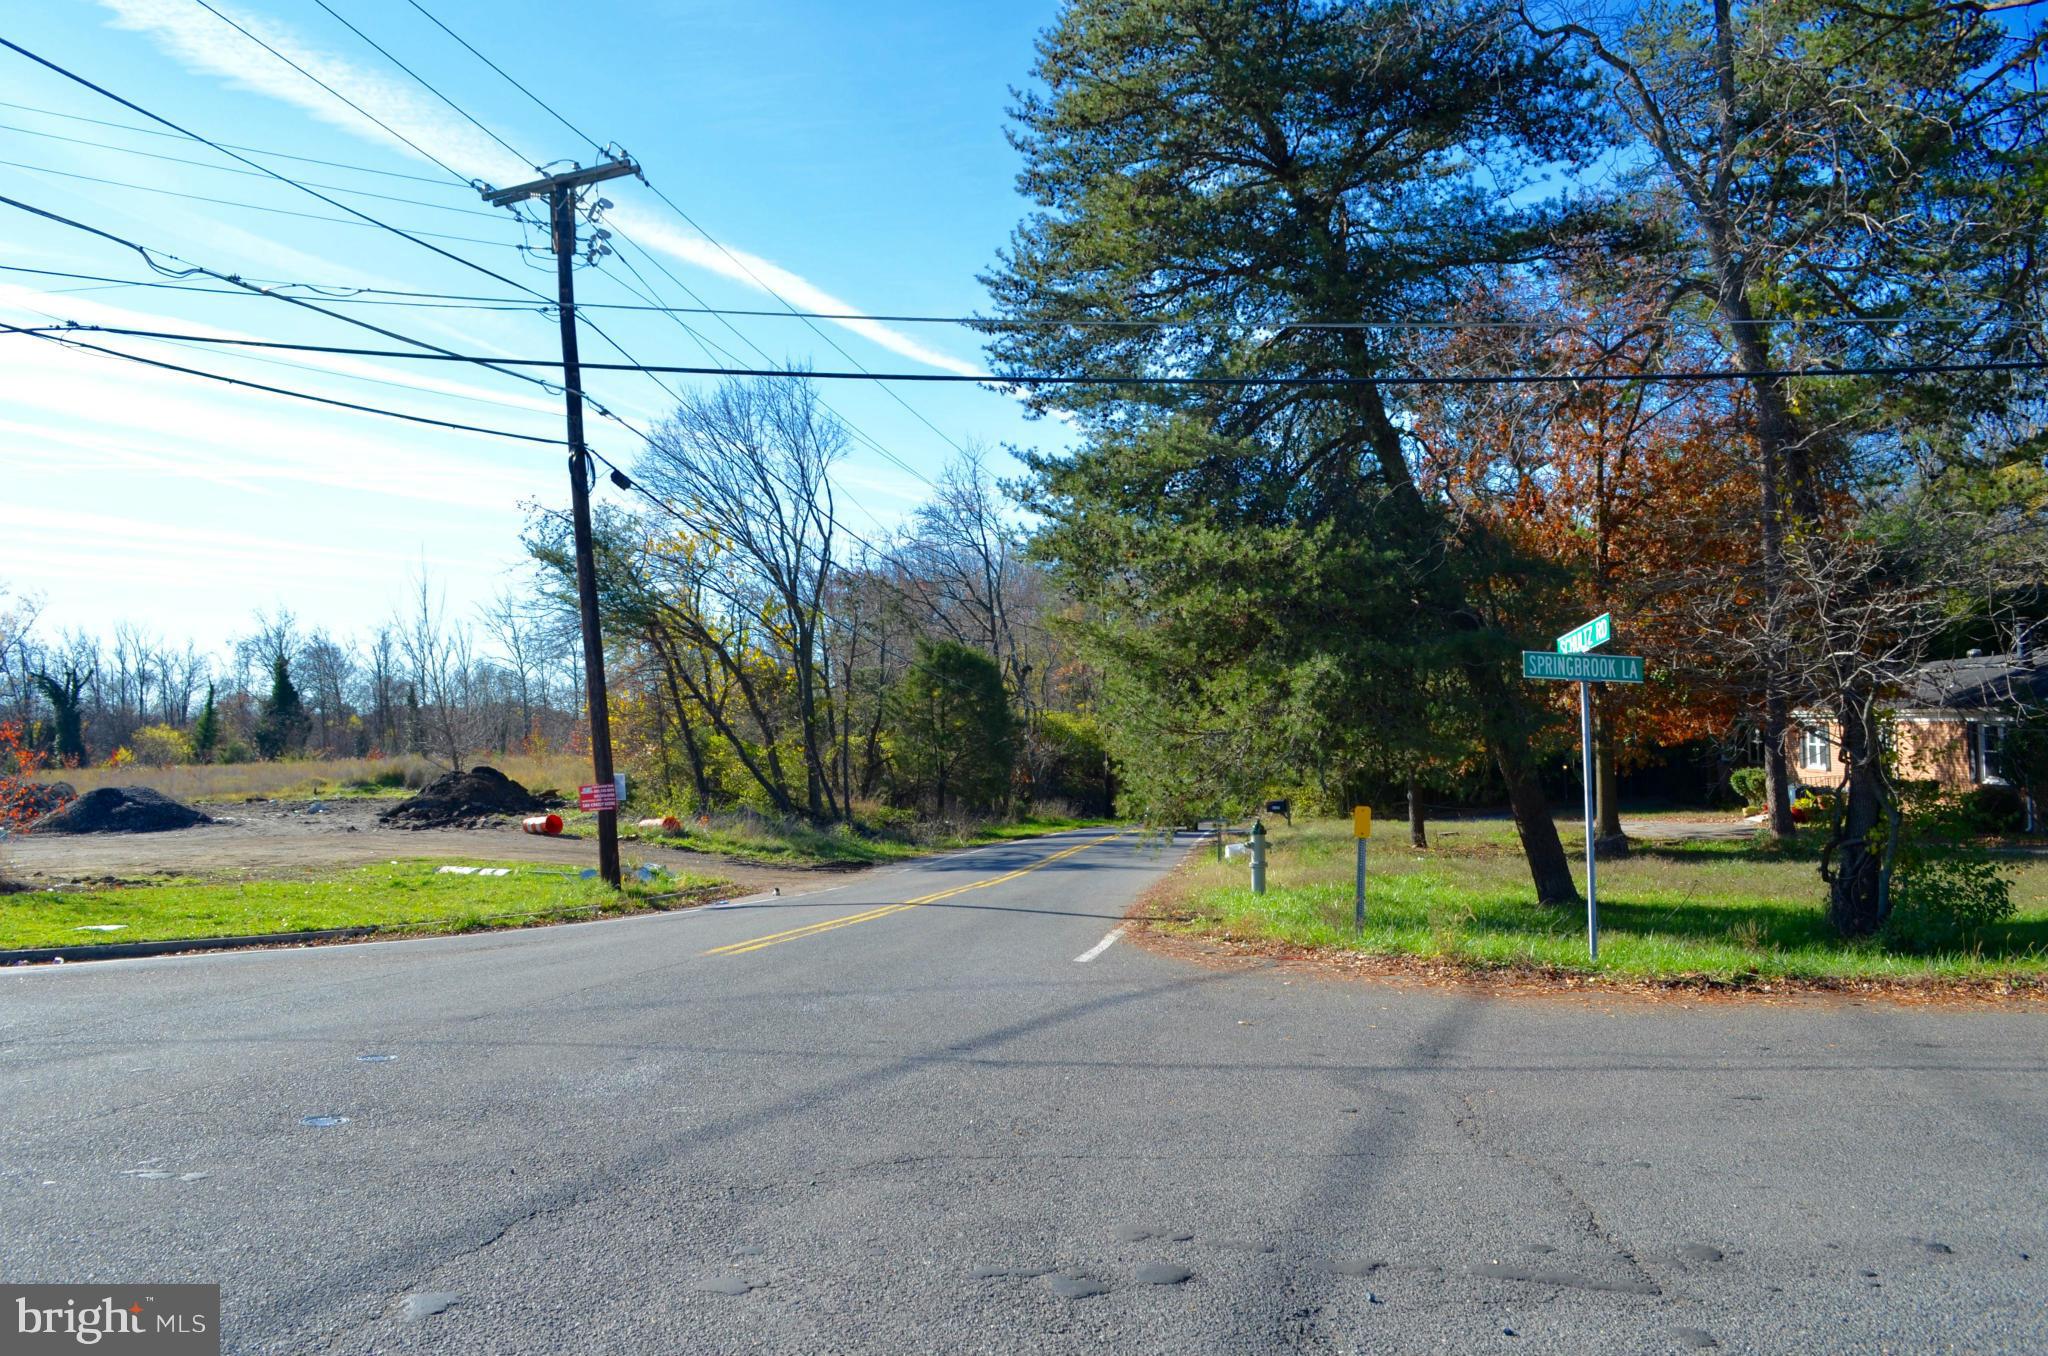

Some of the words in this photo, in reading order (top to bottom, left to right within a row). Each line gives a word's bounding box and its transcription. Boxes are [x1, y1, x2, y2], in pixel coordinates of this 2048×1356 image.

[1560, 625, 1593, 654] SCHULTZ
[1595, 619, 1607, 641] RD
[1529, 654, 1617, 678] SPRINGBROOK
[1622, 659, 1638, 679] LA
